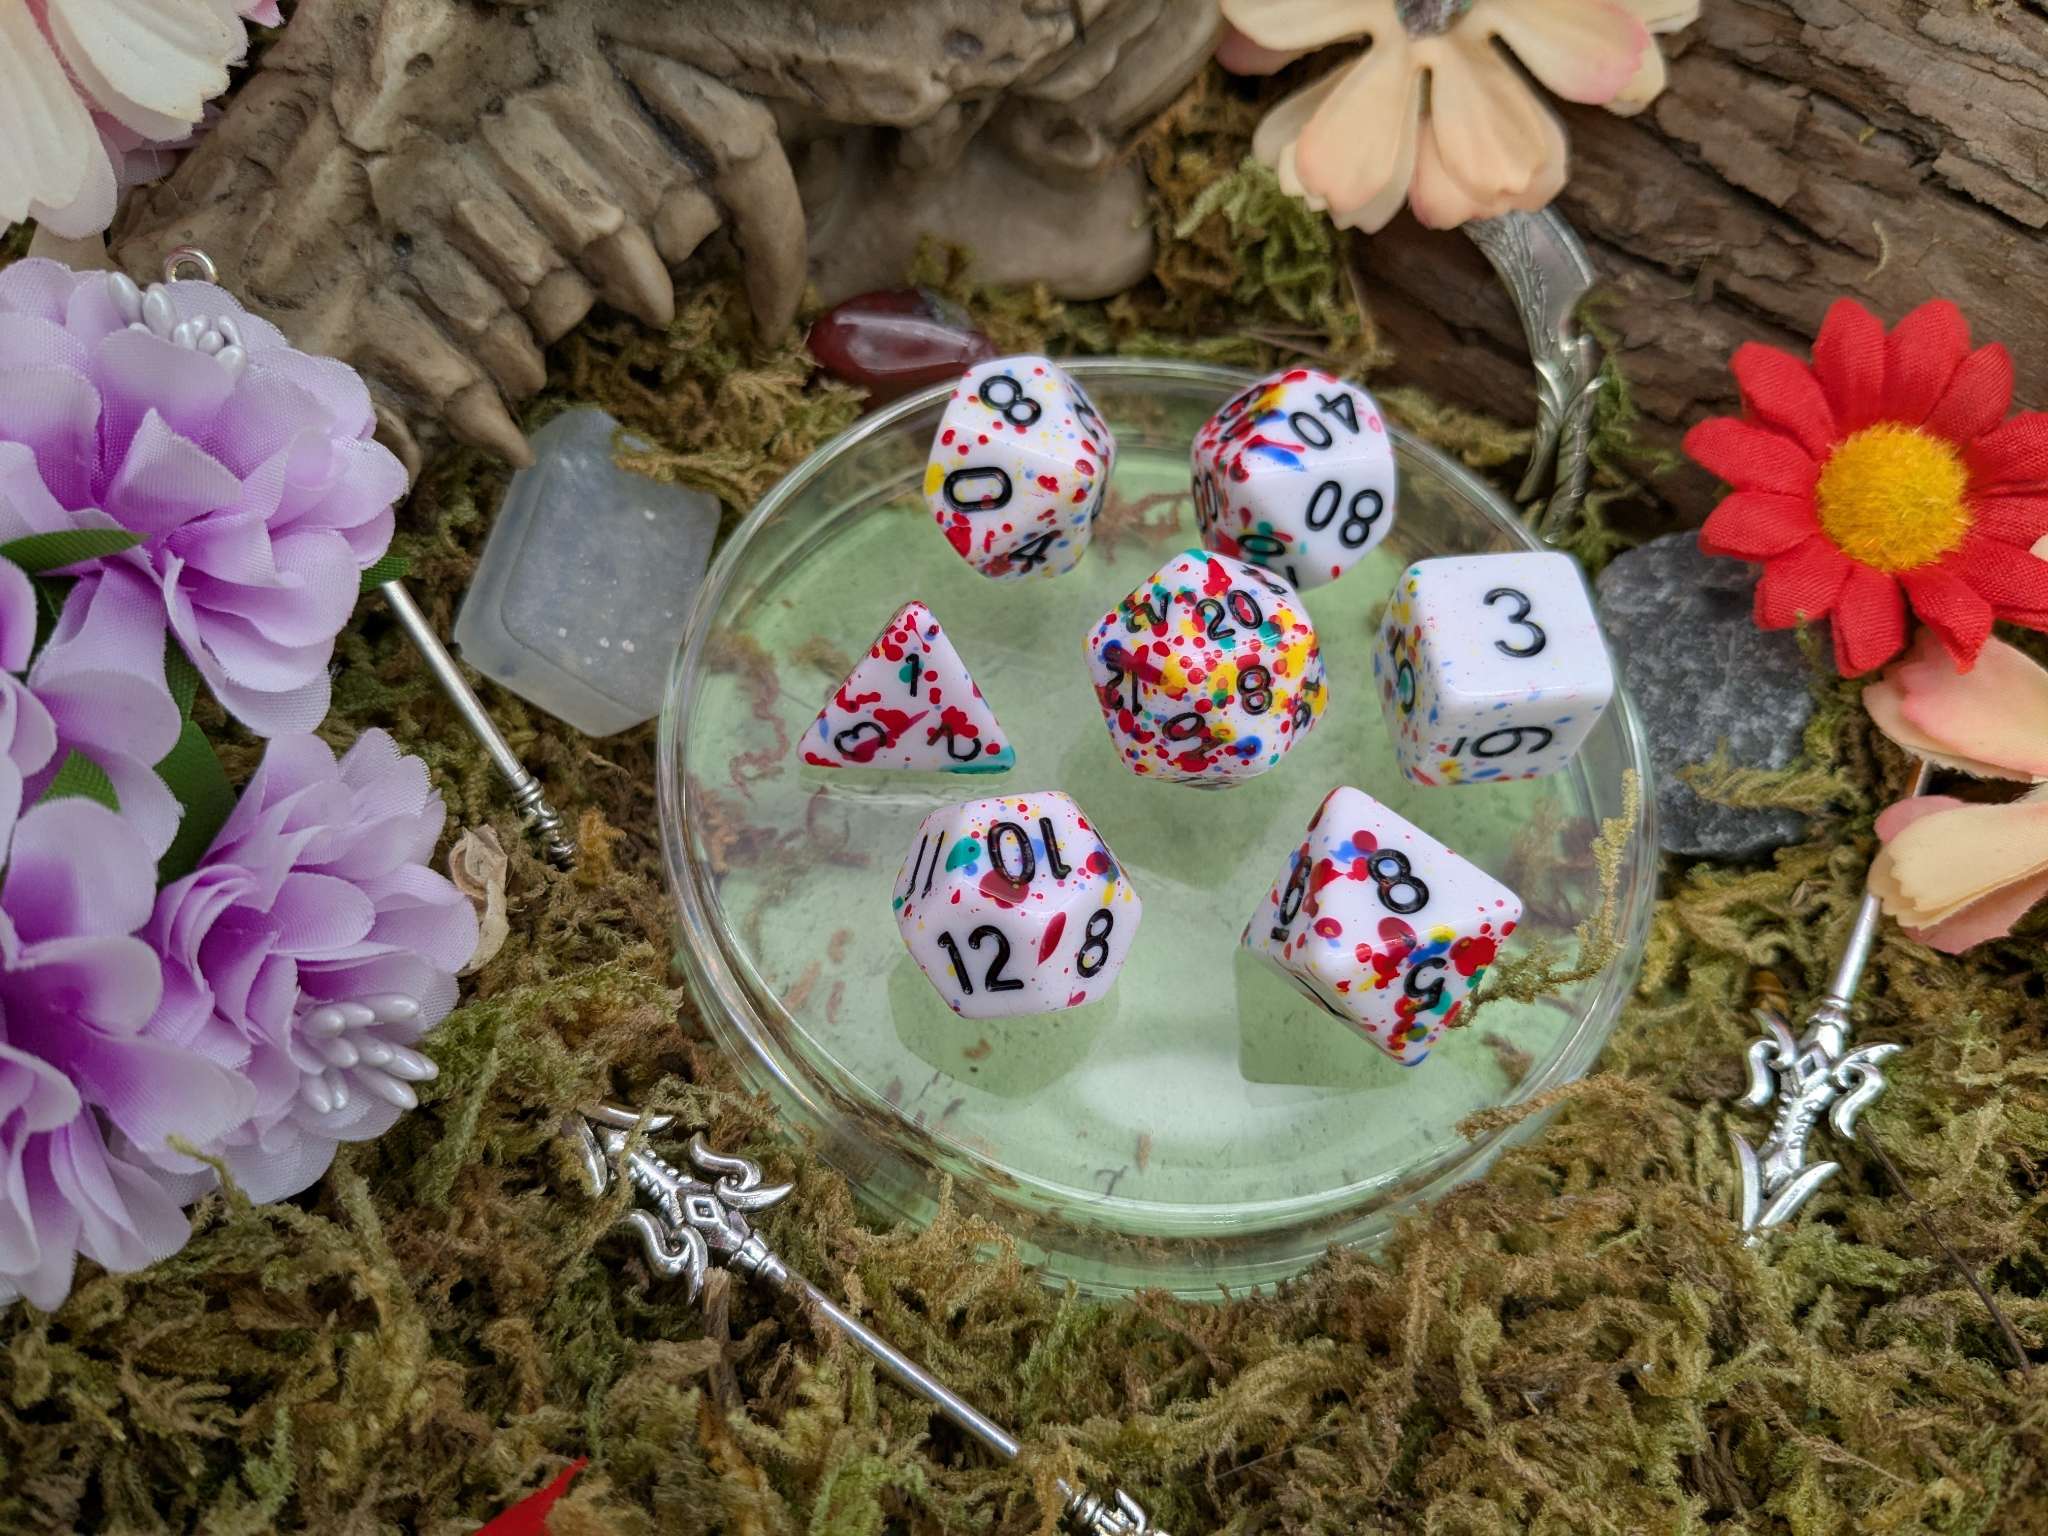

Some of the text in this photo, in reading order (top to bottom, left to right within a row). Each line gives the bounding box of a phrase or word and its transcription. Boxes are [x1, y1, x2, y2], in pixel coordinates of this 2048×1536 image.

[979, 375, 1042, 427] 8
[1288, 393, 1360, 450] 40
[943, 466, 1013, 512] 0
[1305, 480, 1384, 549] 80
[1008, 530, 1063, 574] 4
[1196, 589, 1264, 641] 20
[1483, 587, 1547, 659] 3
[905, 653, 920, 698] 1
[1236, 664, 1273, 716] 8
[834, 721, 888, 758] 3
[987, 816, 1073, 886] 10
[1367, 848, 1430, 915] 8
[937, 924, 1025, 995] 12
[1076, 908, 1114, 979] 8
[1403, 956, 1448, 1015] 5
